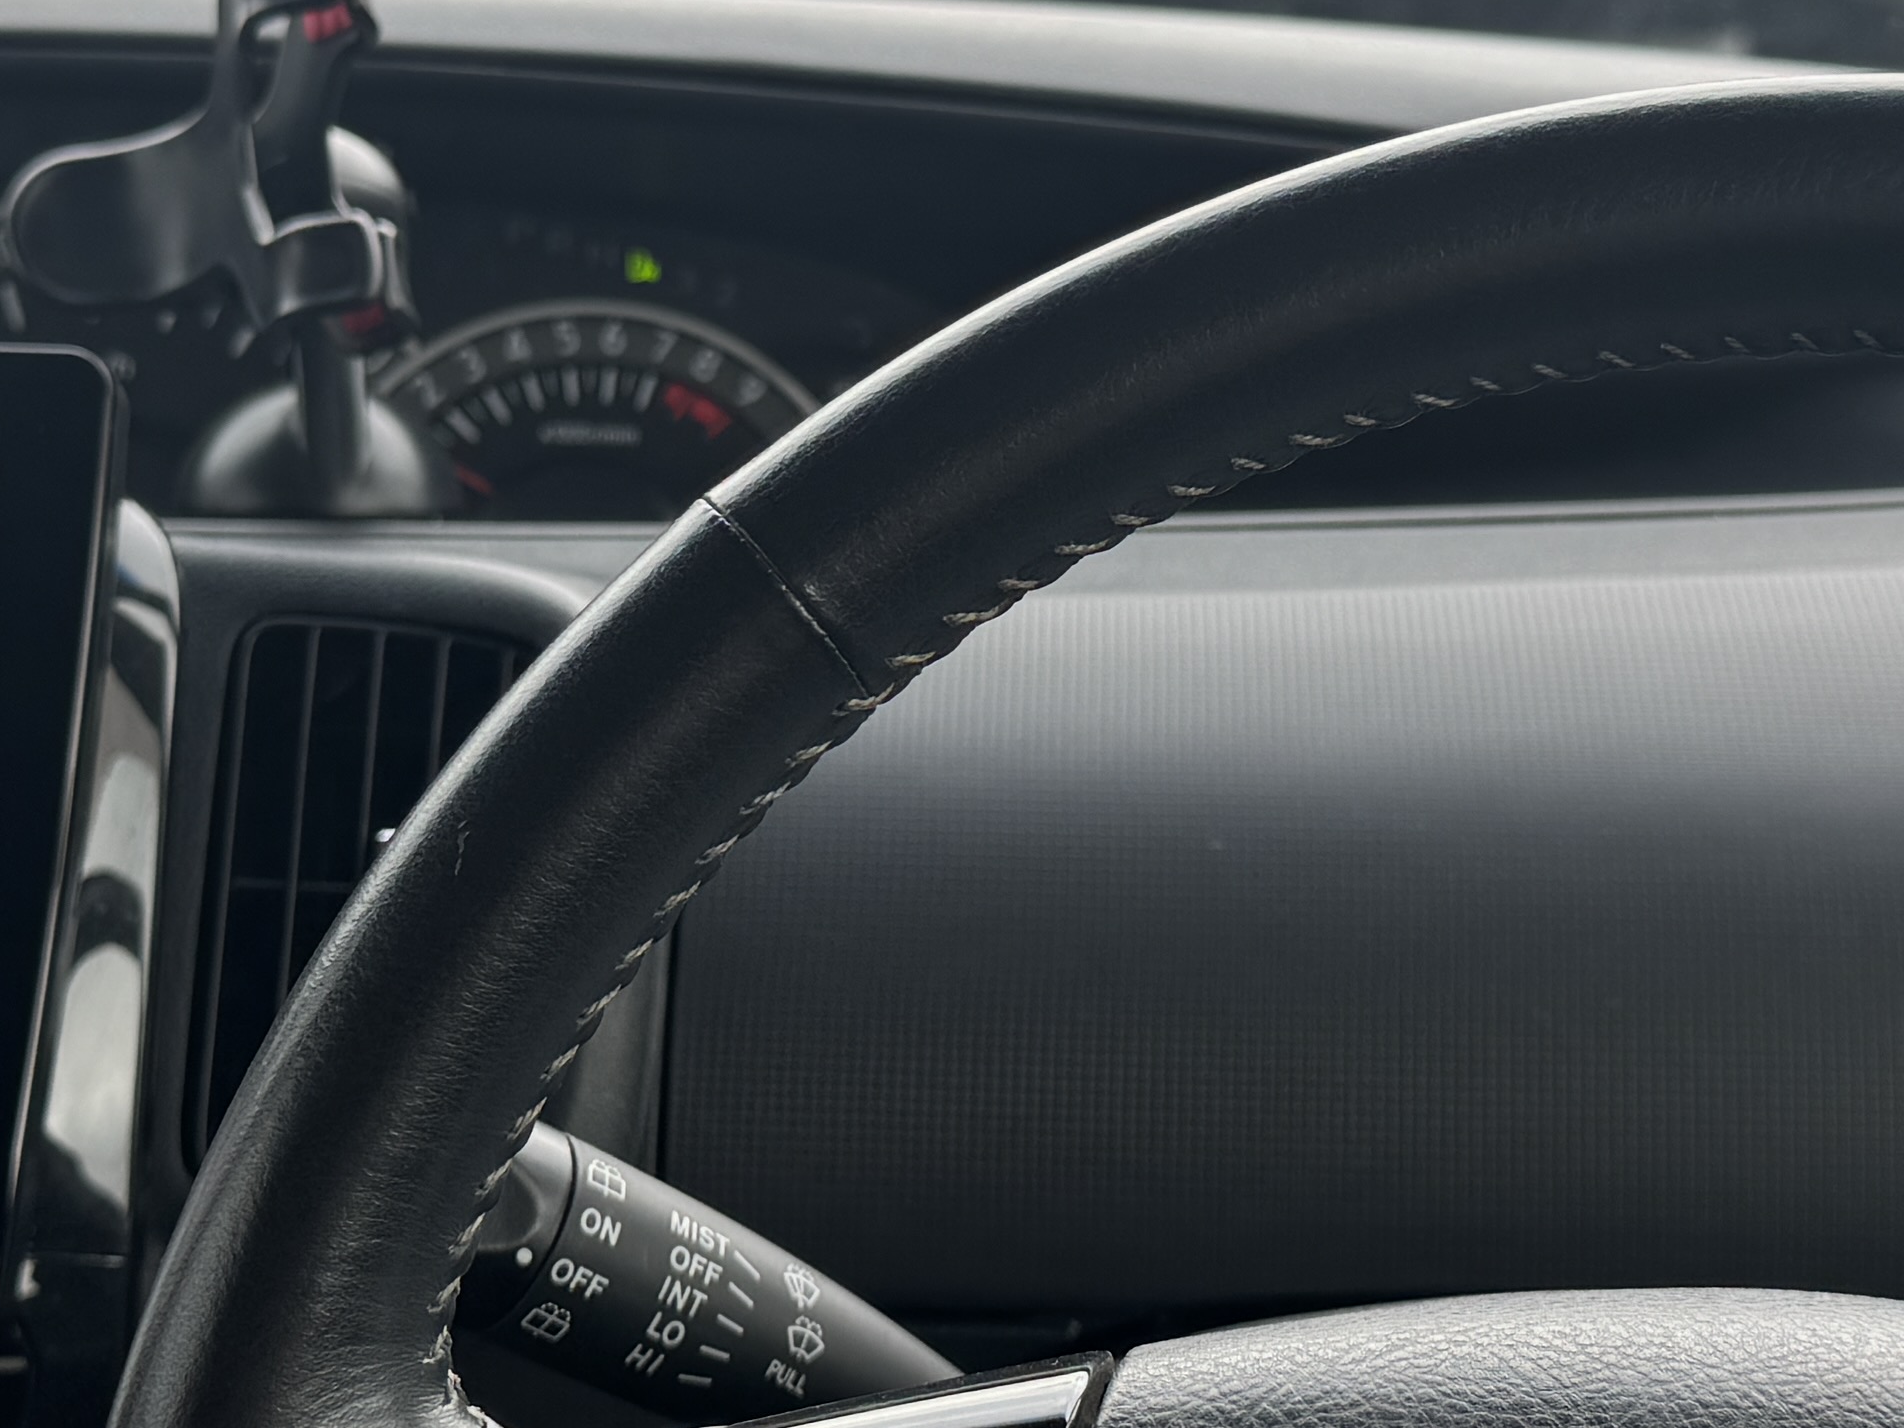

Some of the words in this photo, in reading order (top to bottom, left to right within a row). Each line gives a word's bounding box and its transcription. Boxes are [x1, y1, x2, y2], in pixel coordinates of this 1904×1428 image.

[580, 1207, 623, 1247] ON
[670, 1210, 731, 1258] MIST
[550, 1257, 610, 1302] OFF
[670, 1244, 724, 1287] OFF
[657, 1275, 708, 1320] INT
[646, 1310, 686, 1350] LO
[624, 1342, 665, 1376] HI
[764, 1357, 806, 1399] PULL
